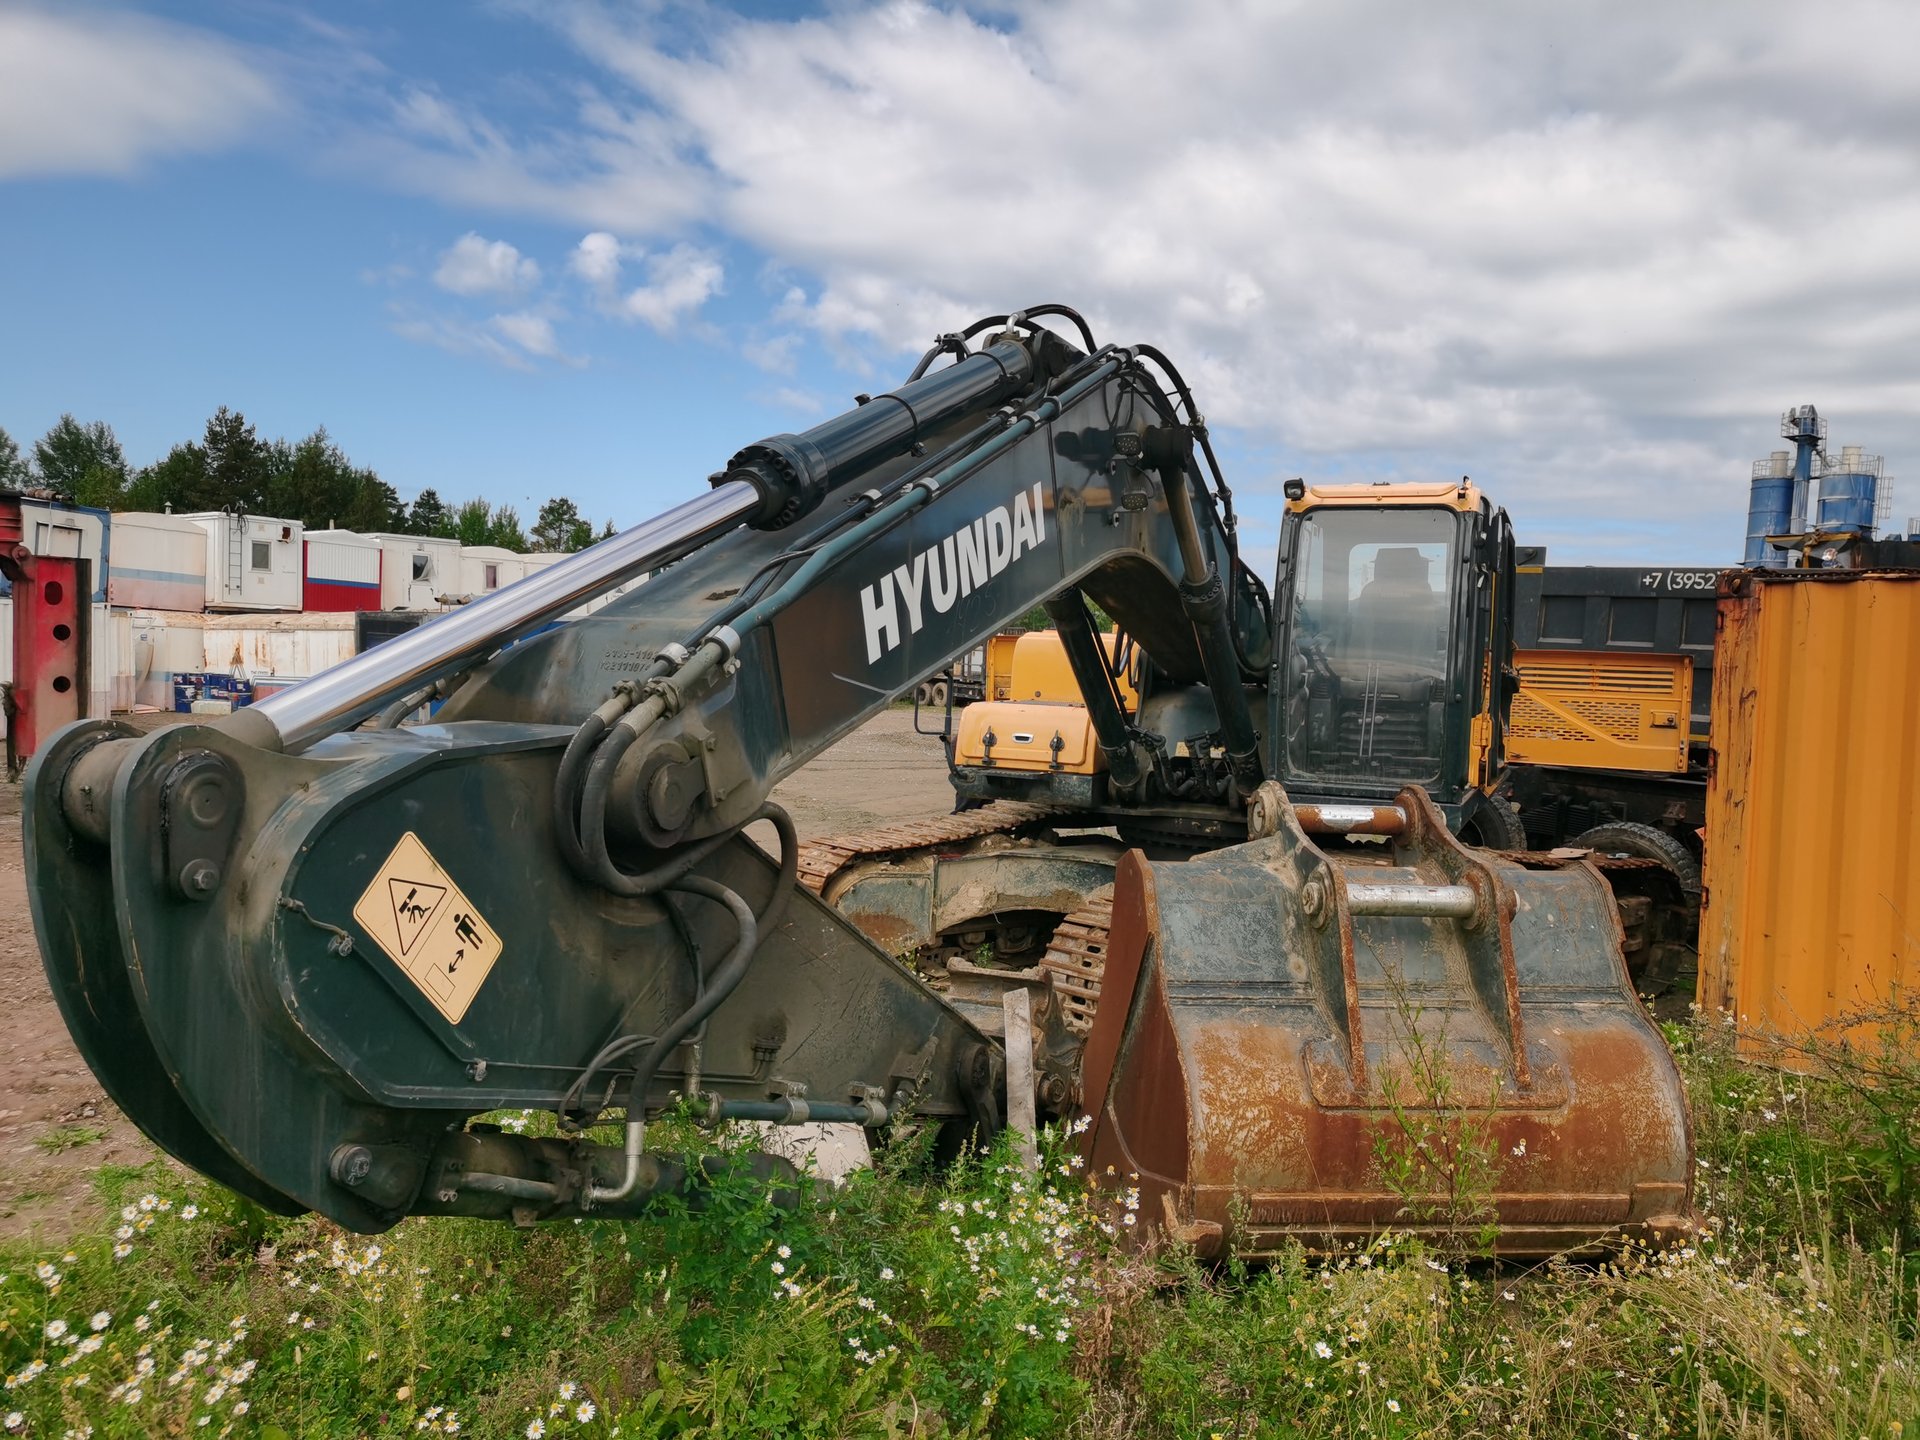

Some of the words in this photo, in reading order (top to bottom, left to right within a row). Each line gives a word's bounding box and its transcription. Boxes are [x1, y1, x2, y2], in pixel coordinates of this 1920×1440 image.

[860, 481, 1046, 665] HYUNDAI
[1642, 572, 1662, 589] +7
[1667, 570, 1720, 591] (3952
